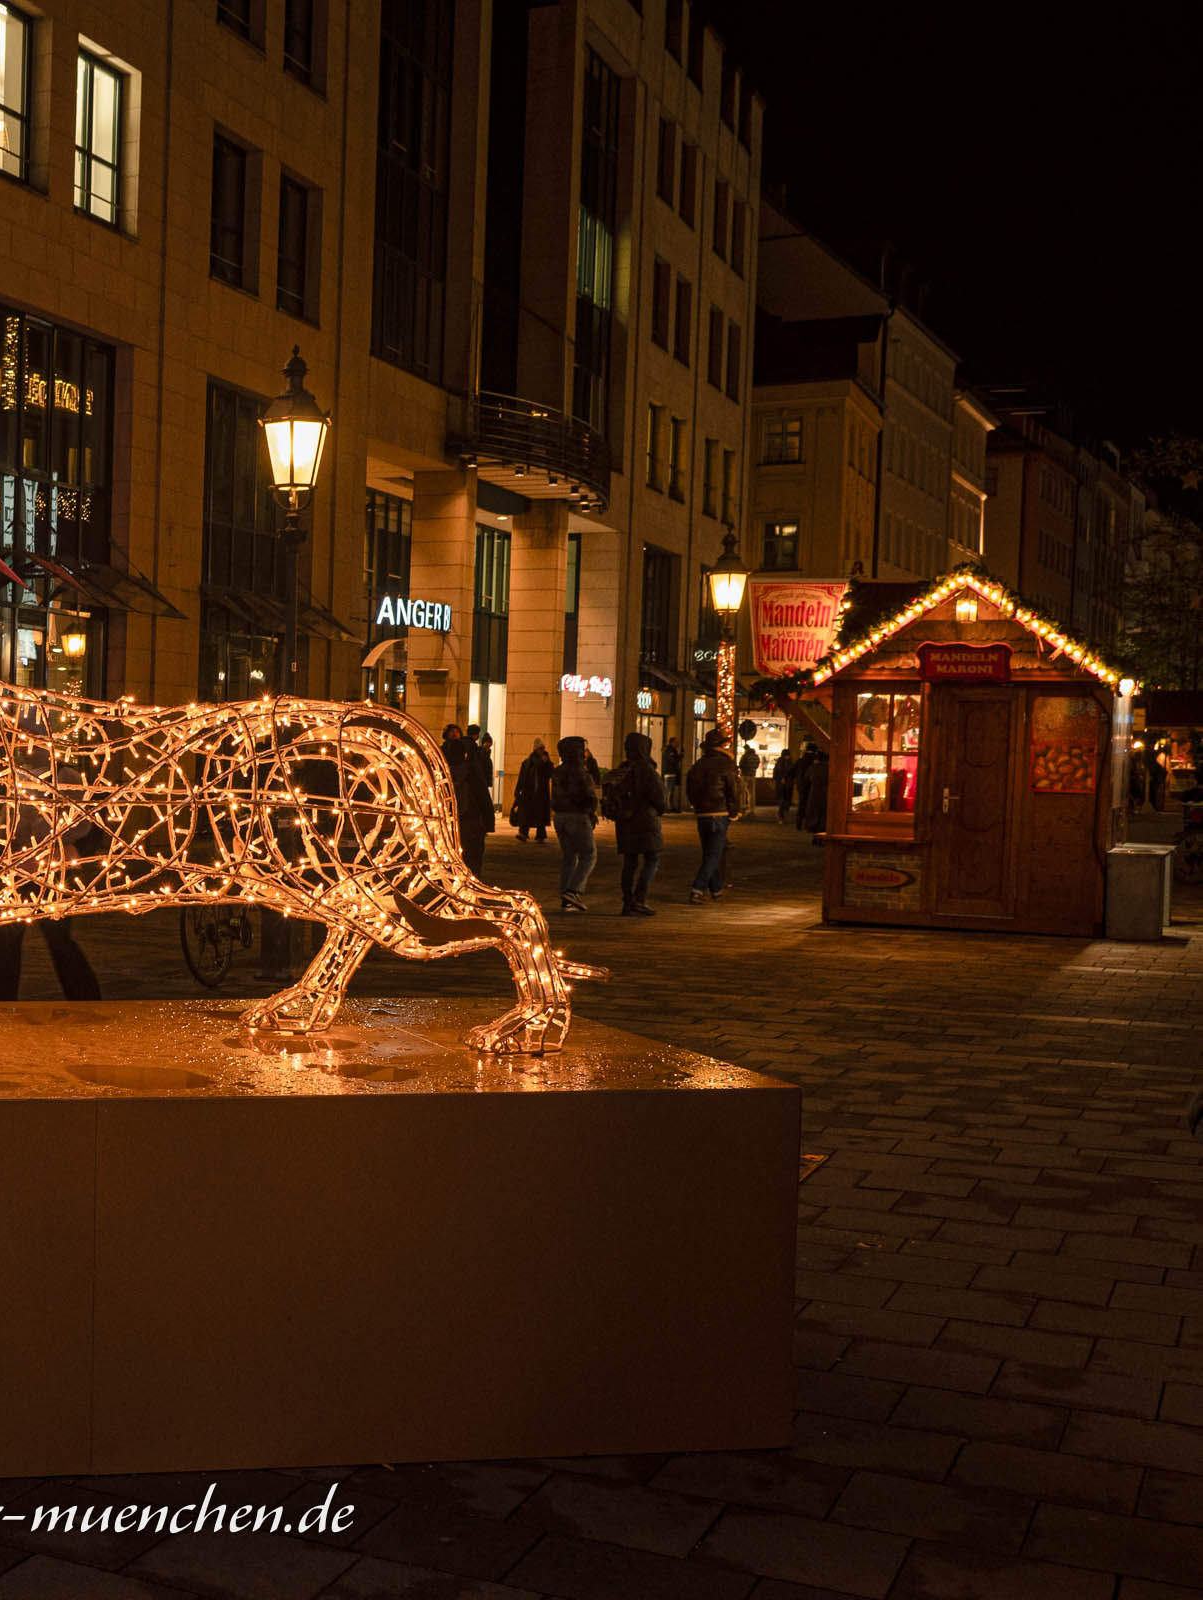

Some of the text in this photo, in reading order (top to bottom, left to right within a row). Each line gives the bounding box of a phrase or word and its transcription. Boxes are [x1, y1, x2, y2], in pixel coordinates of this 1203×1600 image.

[761, 600, 832, 628] Mandeln
[758, 634, 825, 662] Maronen
[929, 651, 999, 663] MANDELN
[936, 663, 995, 675] MARONI
